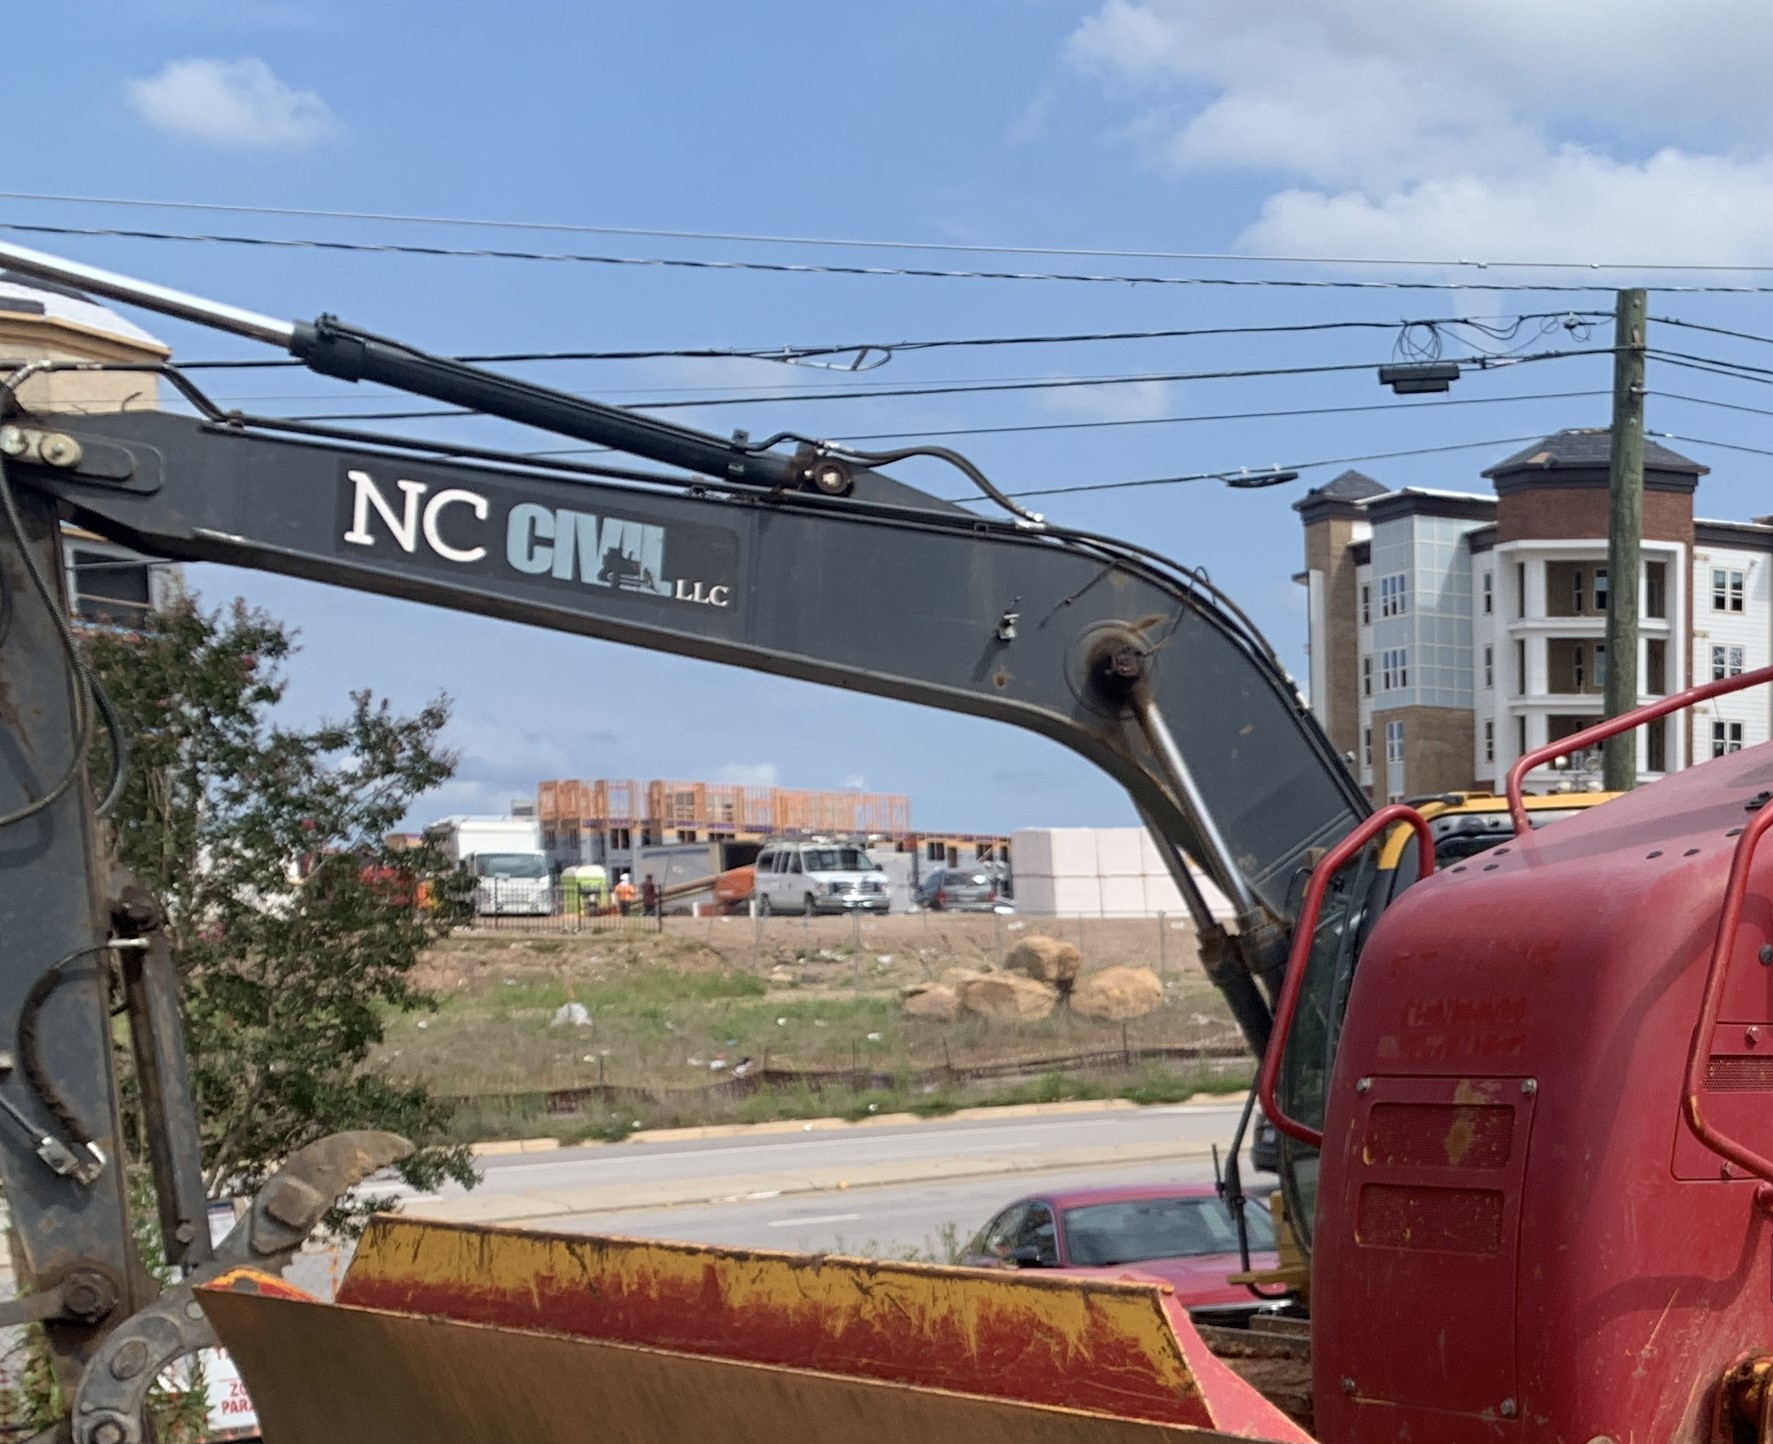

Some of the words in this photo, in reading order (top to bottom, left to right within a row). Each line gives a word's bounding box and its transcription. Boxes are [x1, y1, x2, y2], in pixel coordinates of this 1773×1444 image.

[343, 469, 489, 563] NC
[506, 502, 673, 597] CIVIL
[674, 578, 731, 608] LLC
[221, 1399, 252, 1415] PAR
